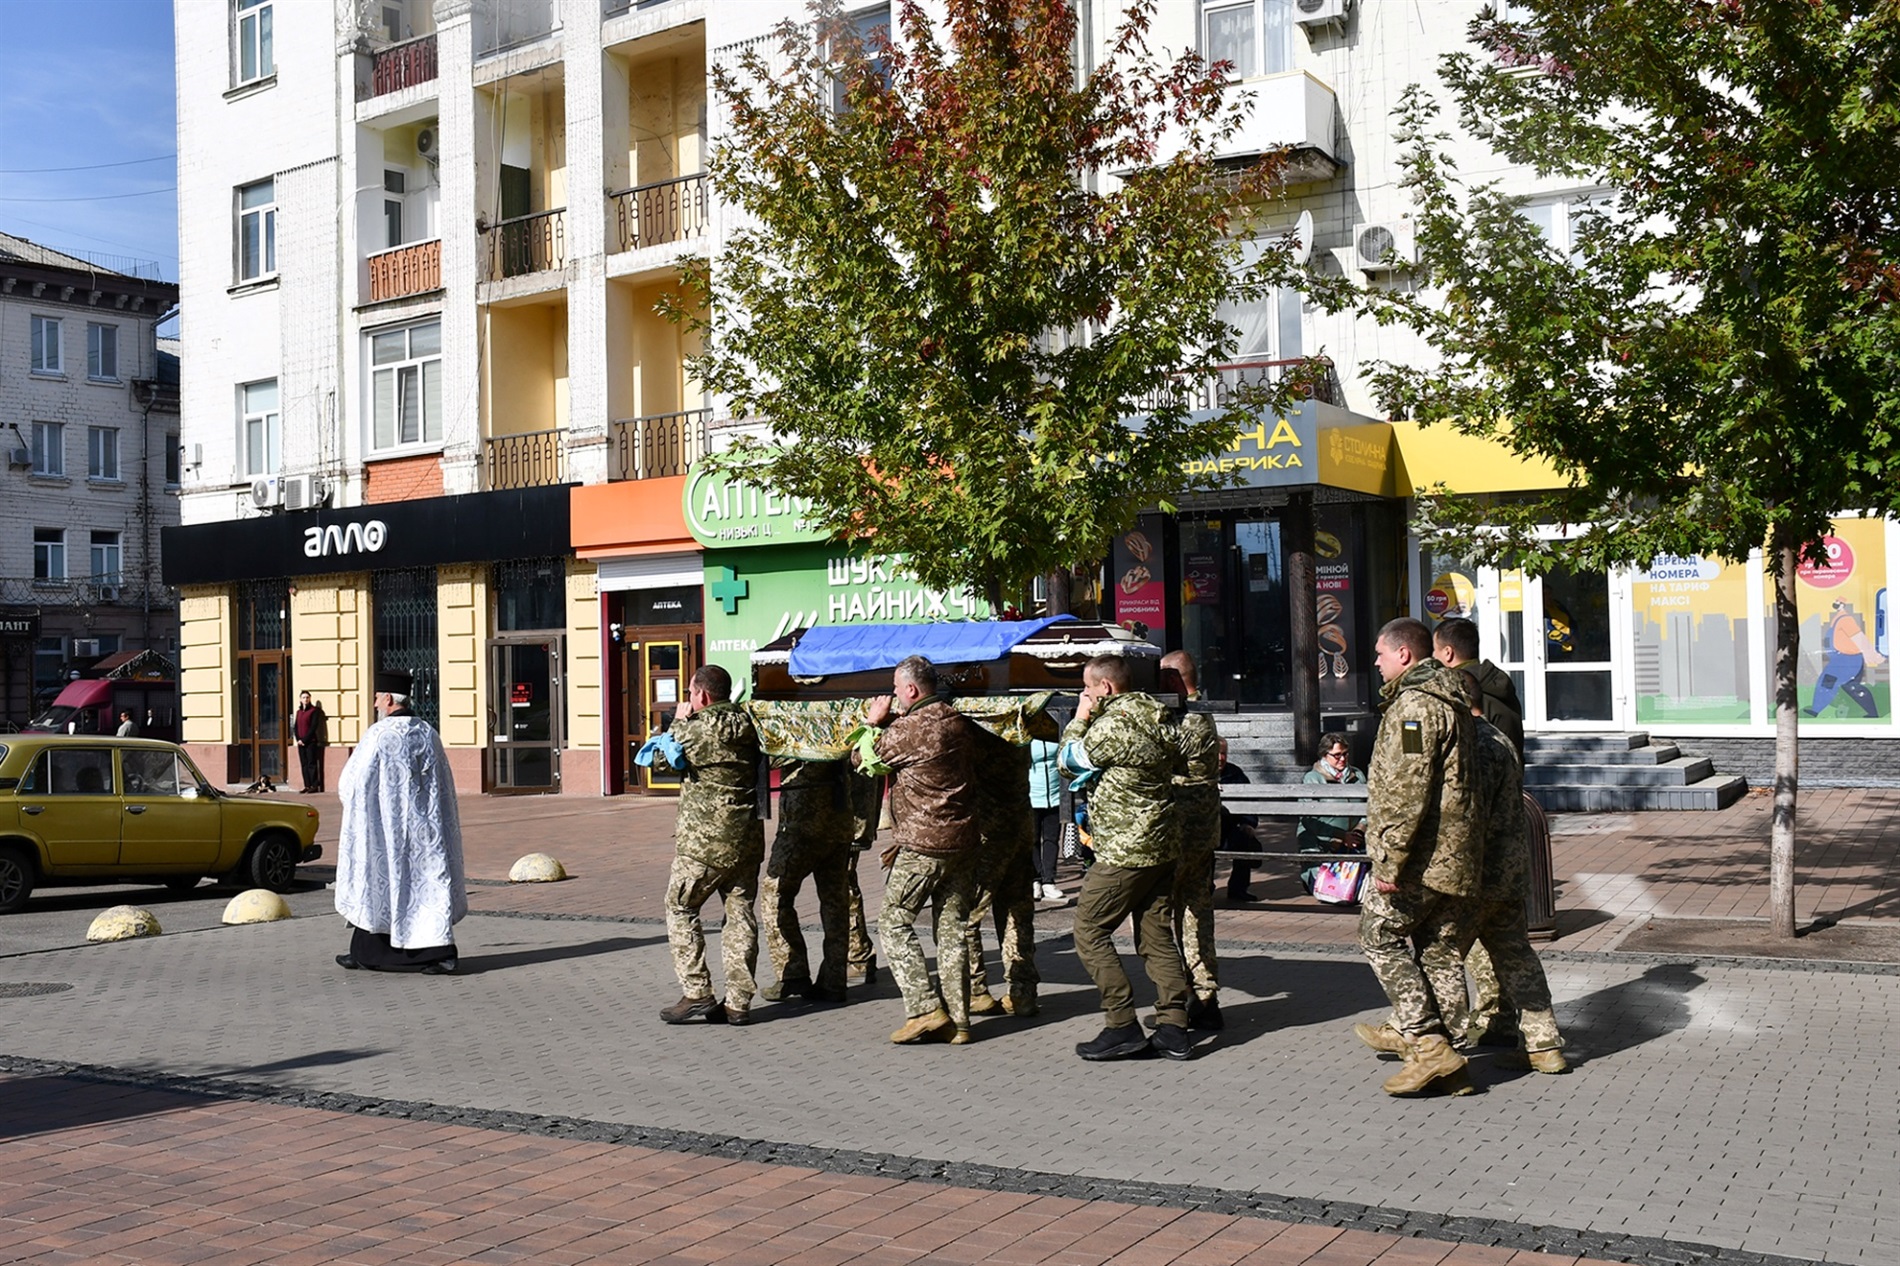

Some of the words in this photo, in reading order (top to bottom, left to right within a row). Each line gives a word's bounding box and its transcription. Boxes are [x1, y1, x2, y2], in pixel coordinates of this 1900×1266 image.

[1180, 453, 1303, 475] ФАБРИКА
[720, 524, 758, 542] НИЗЬКІ
[1315, 563, 1349, 574] МІНЮЙ
[1650, 569, 1700, 579] НОМЕРА
[1323, 581, 1342, 589] НОВІ
[1650, 584, 1667, 593] НА
[1669, 582, 1710, 592] ТАРИФ
[652, 601, 682, 609] АПТЕКА
[828, 585, 976, 623] НАЙНИЖЧІ
[1651, 596, 1690, 606] МАКСІ
[709, 639, 759, 652] АПТЕКА
